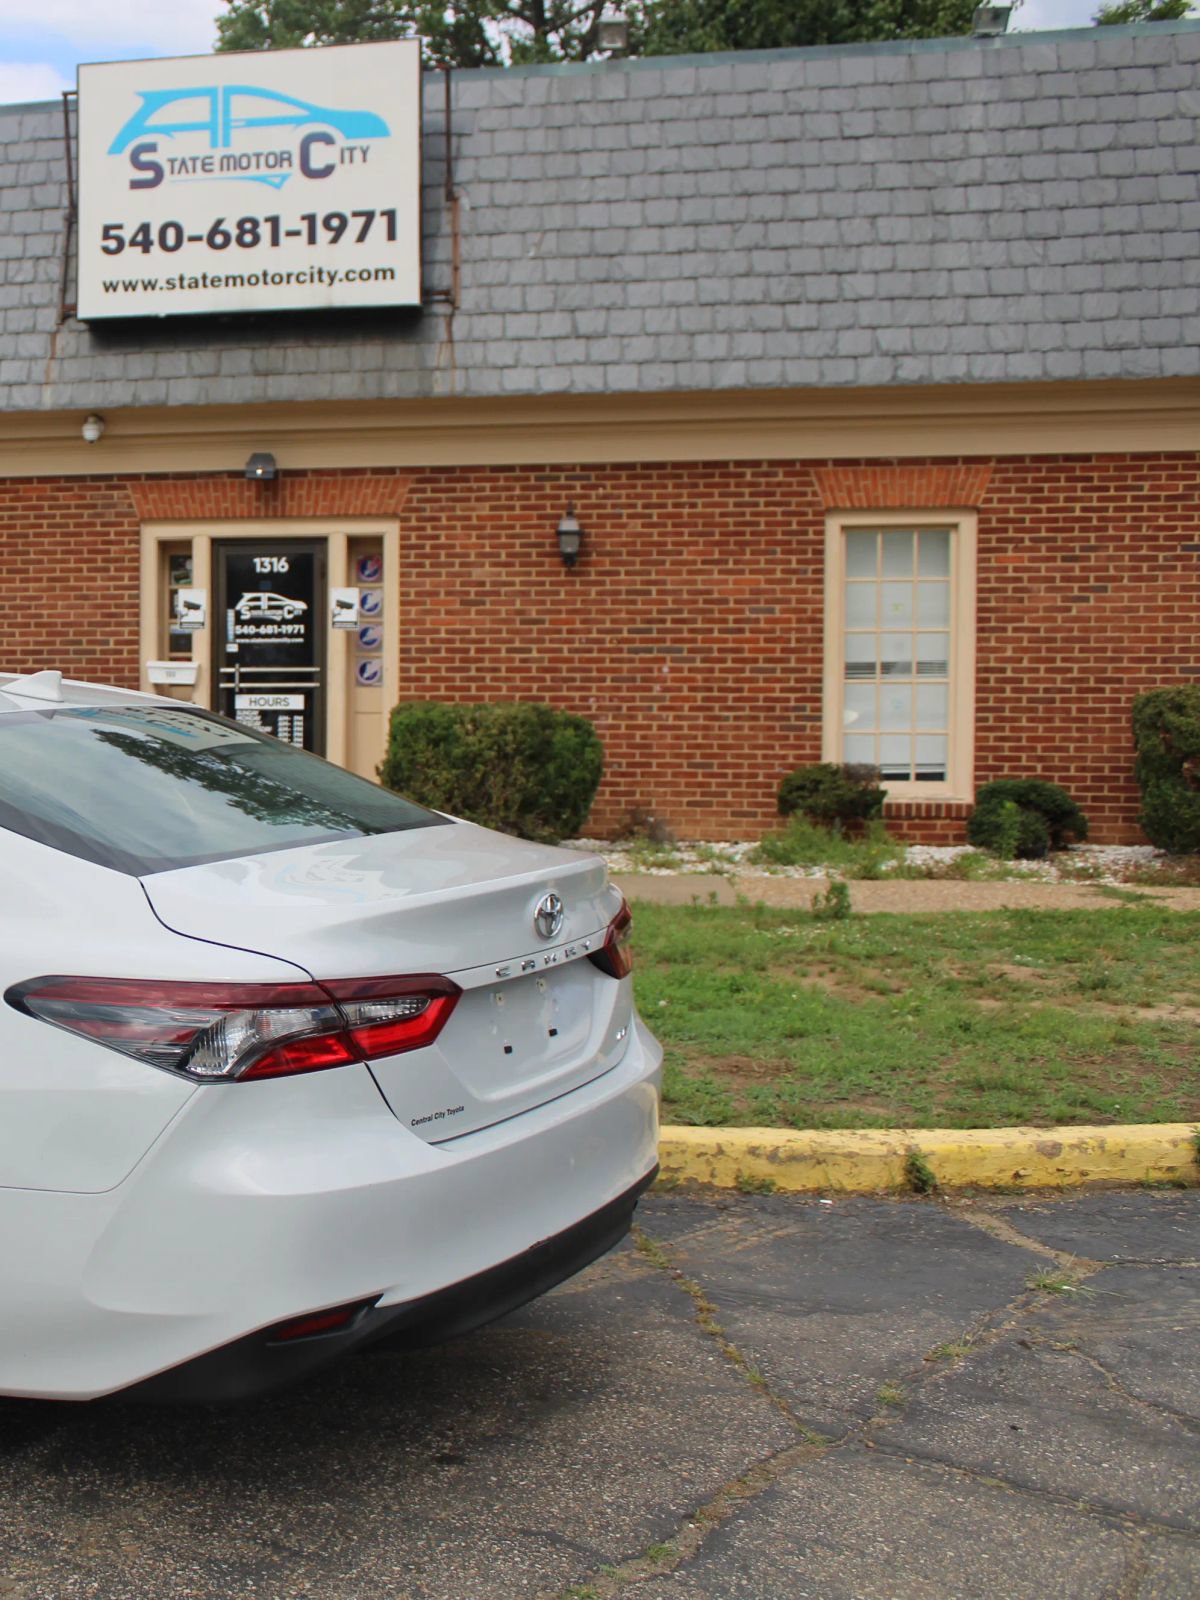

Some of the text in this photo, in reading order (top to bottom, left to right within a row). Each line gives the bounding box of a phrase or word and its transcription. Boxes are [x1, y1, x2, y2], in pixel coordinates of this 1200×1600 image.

[128, 131, 371, 190] STATE MOTOR CITY
[100, 207, 398, 256] 540-681-1971
[102, 265, 396, 294] www.statemotorcity.com
[253, 556, 289, 574] 1316
[235, 624, 305, 635] 540-681-1971
[248, 696, 290, 707] HOURS
[410, 1105, 465, 1127] Central City Toyota
